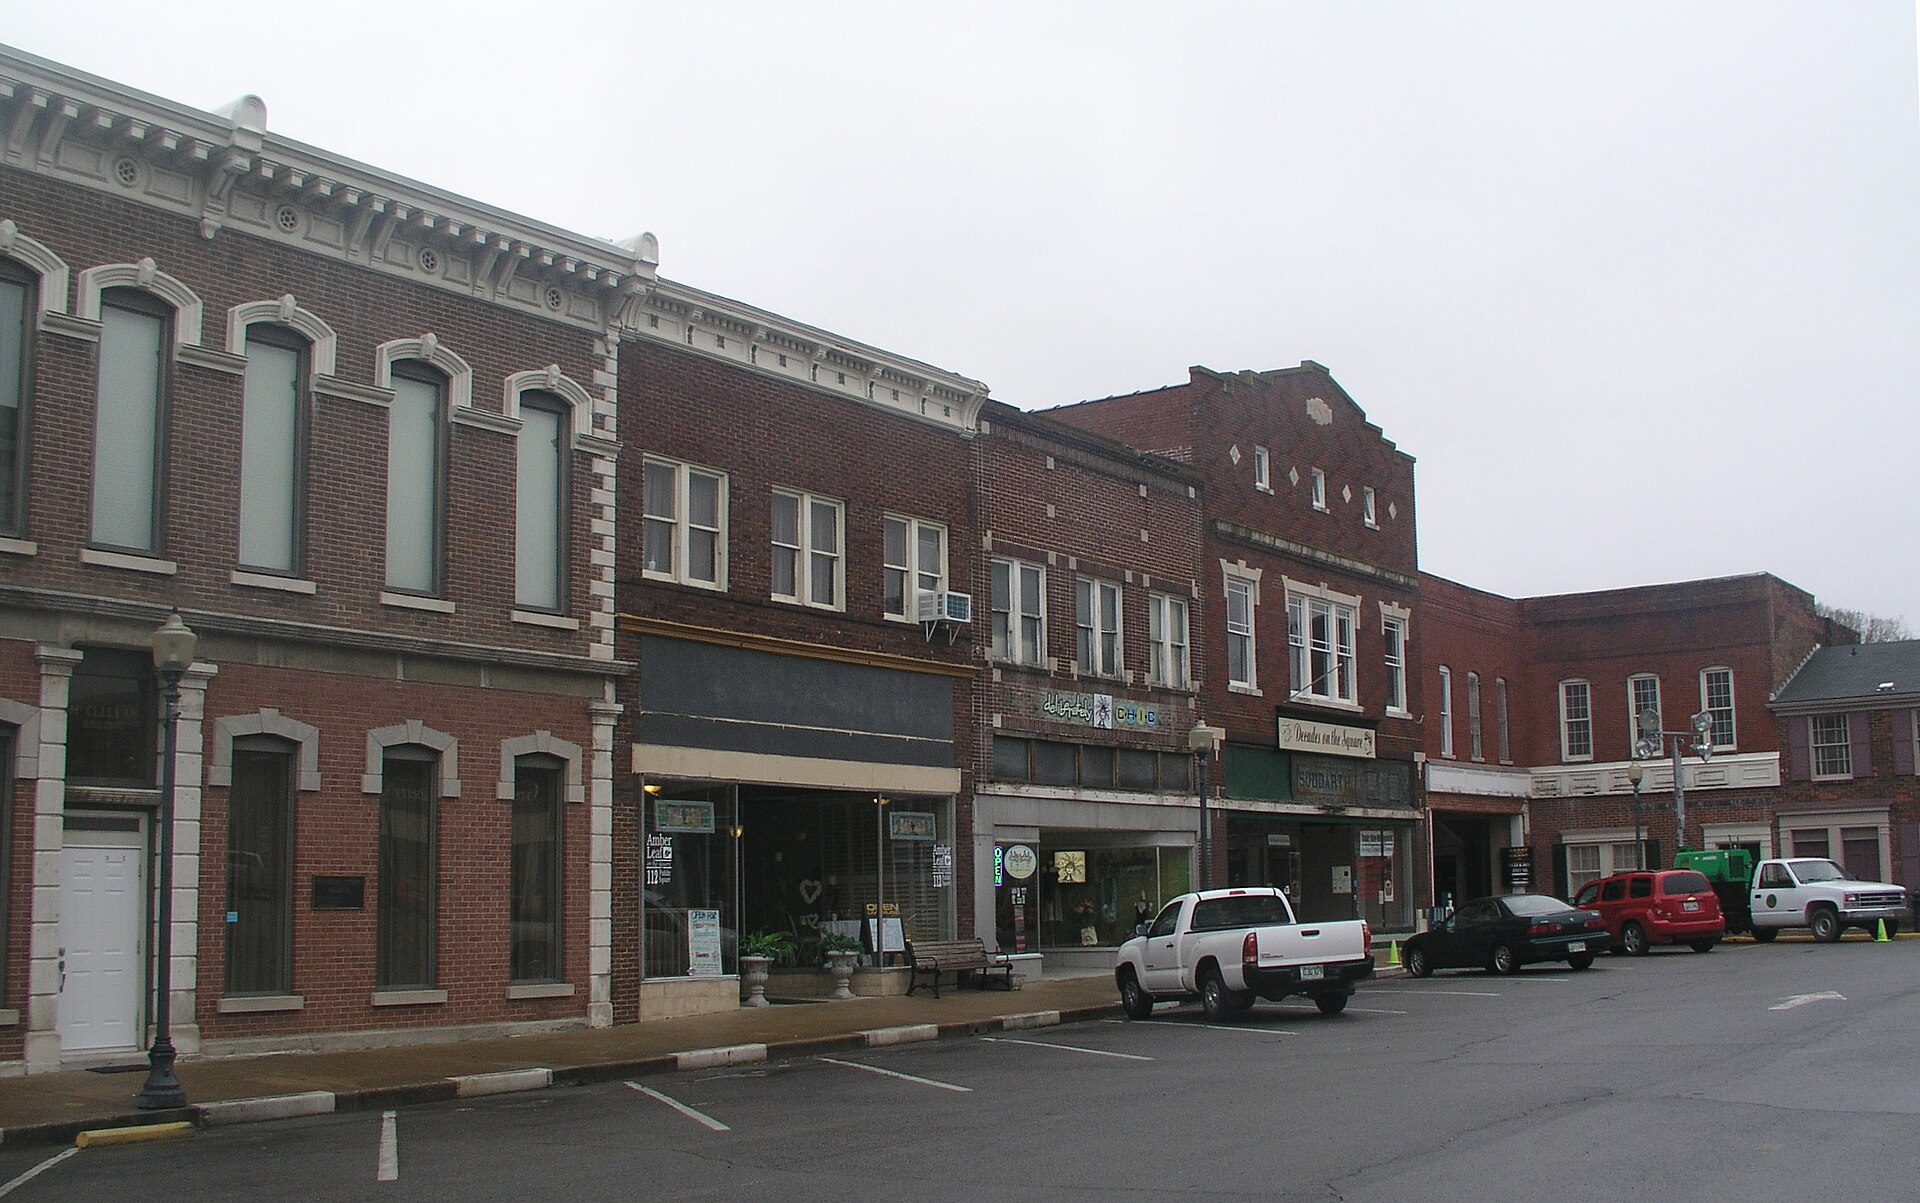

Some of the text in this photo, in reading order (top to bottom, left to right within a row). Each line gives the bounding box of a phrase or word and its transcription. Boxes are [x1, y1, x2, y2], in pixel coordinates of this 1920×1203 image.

[1294, 722, 1321, 744] Decades
[1341, 729, 1363, 751] Square
[646, 833, 672, 846] Amber
[646, 846, 663, 859] Leaf
[994, 847, 1003, 884] OPEN
[647, 869, 659, 885] 112
[866, 903, 899, 911] OEN
